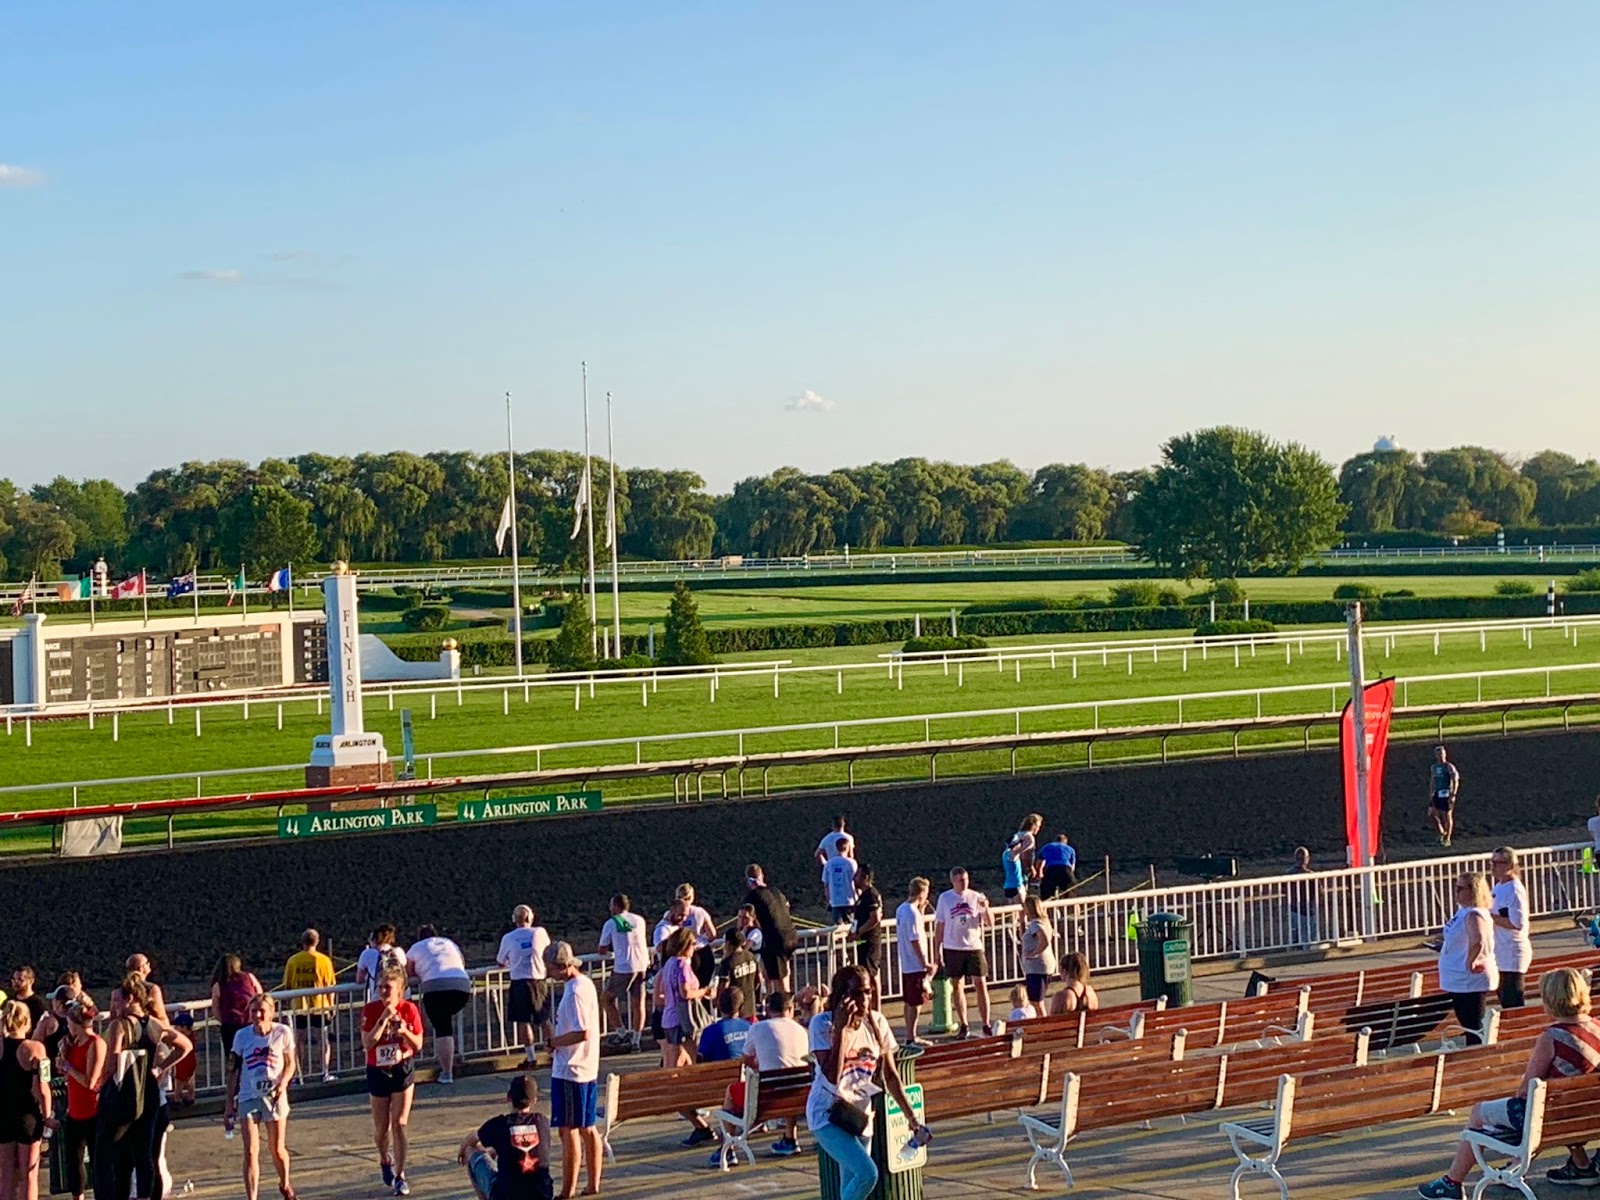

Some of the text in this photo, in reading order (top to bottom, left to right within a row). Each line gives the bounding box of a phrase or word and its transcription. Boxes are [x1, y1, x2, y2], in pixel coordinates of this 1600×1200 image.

[343, 610, 355, 703] FINISH
[339, 739, 376, 749] ARLINGTON
[482, 795, 588, 818] ARLINGTON PARK
[310, 809, 424, 832] ARLINGTON PARK
